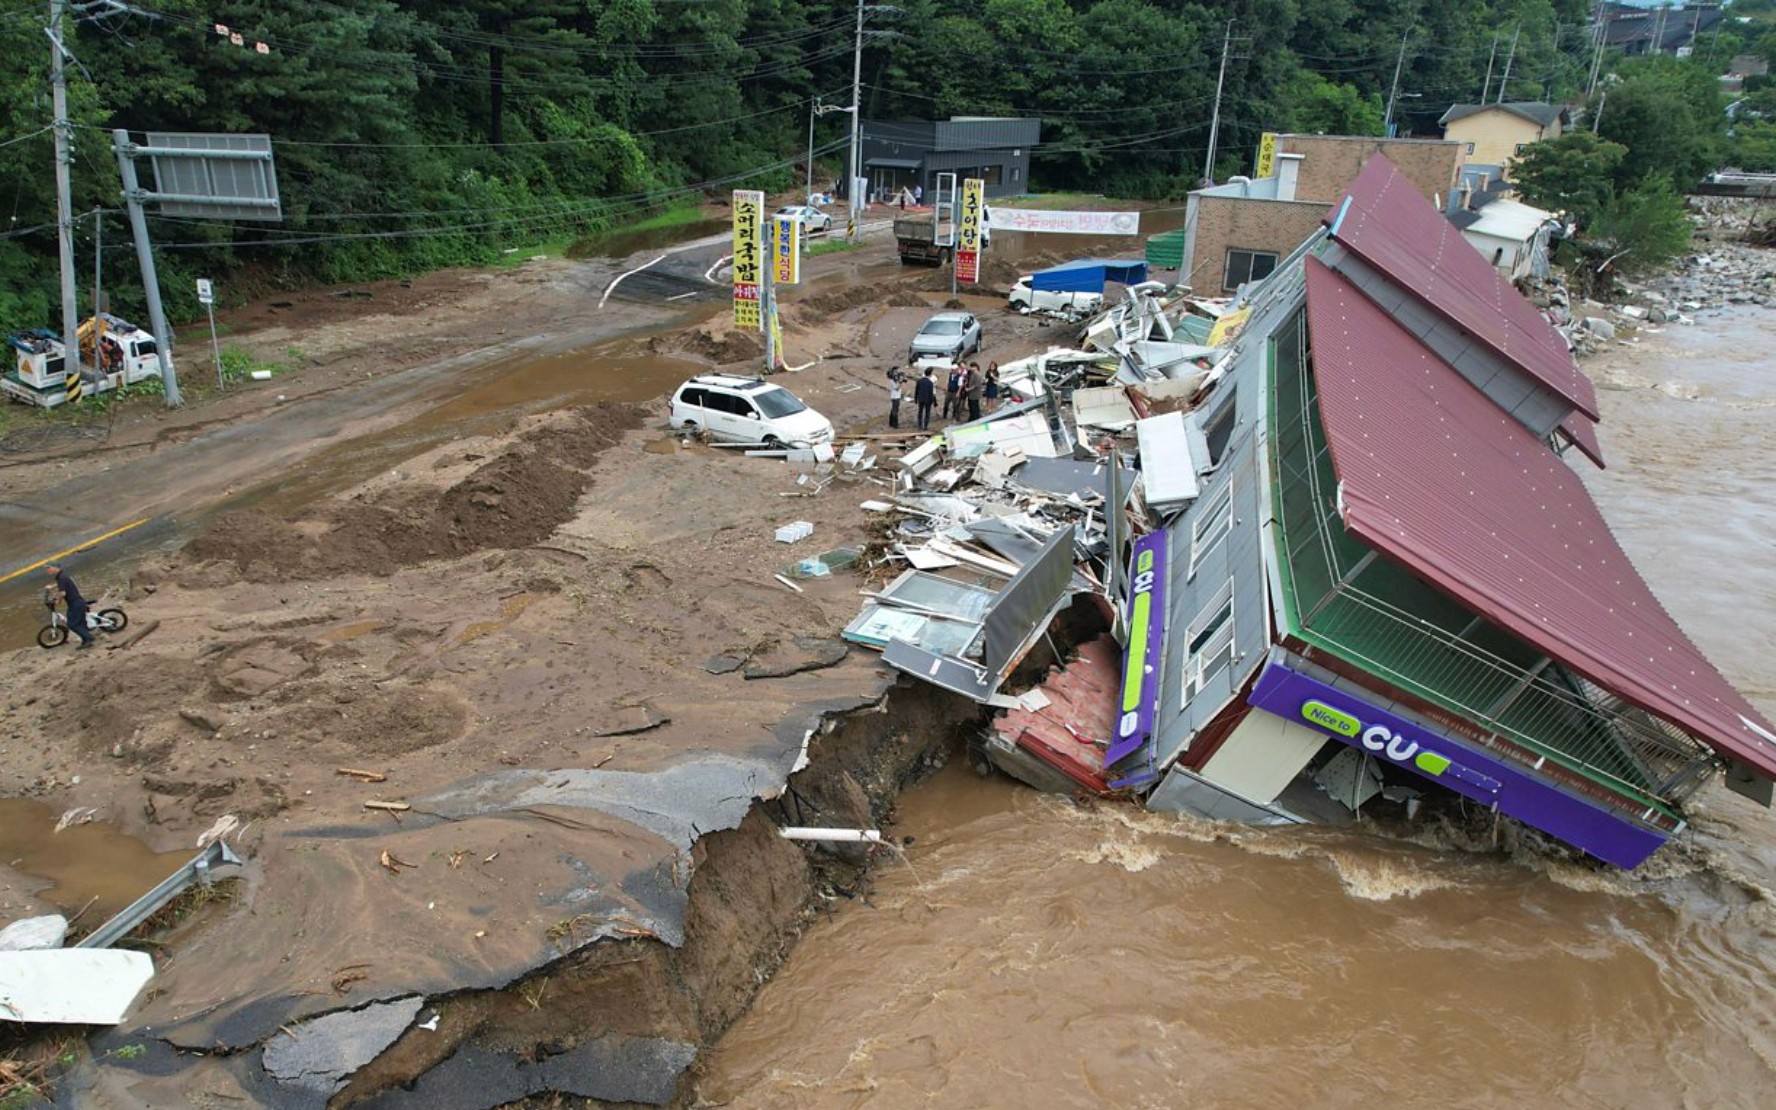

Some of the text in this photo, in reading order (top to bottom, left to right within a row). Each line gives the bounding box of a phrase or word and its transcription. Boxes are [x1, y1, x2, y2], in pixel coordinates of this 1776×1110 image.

[736, 202, 758, 282] 소머리국밥
[963, 192, 978, 244] 추어탕
[1310, 708, 1419, 761] Nice to CU
